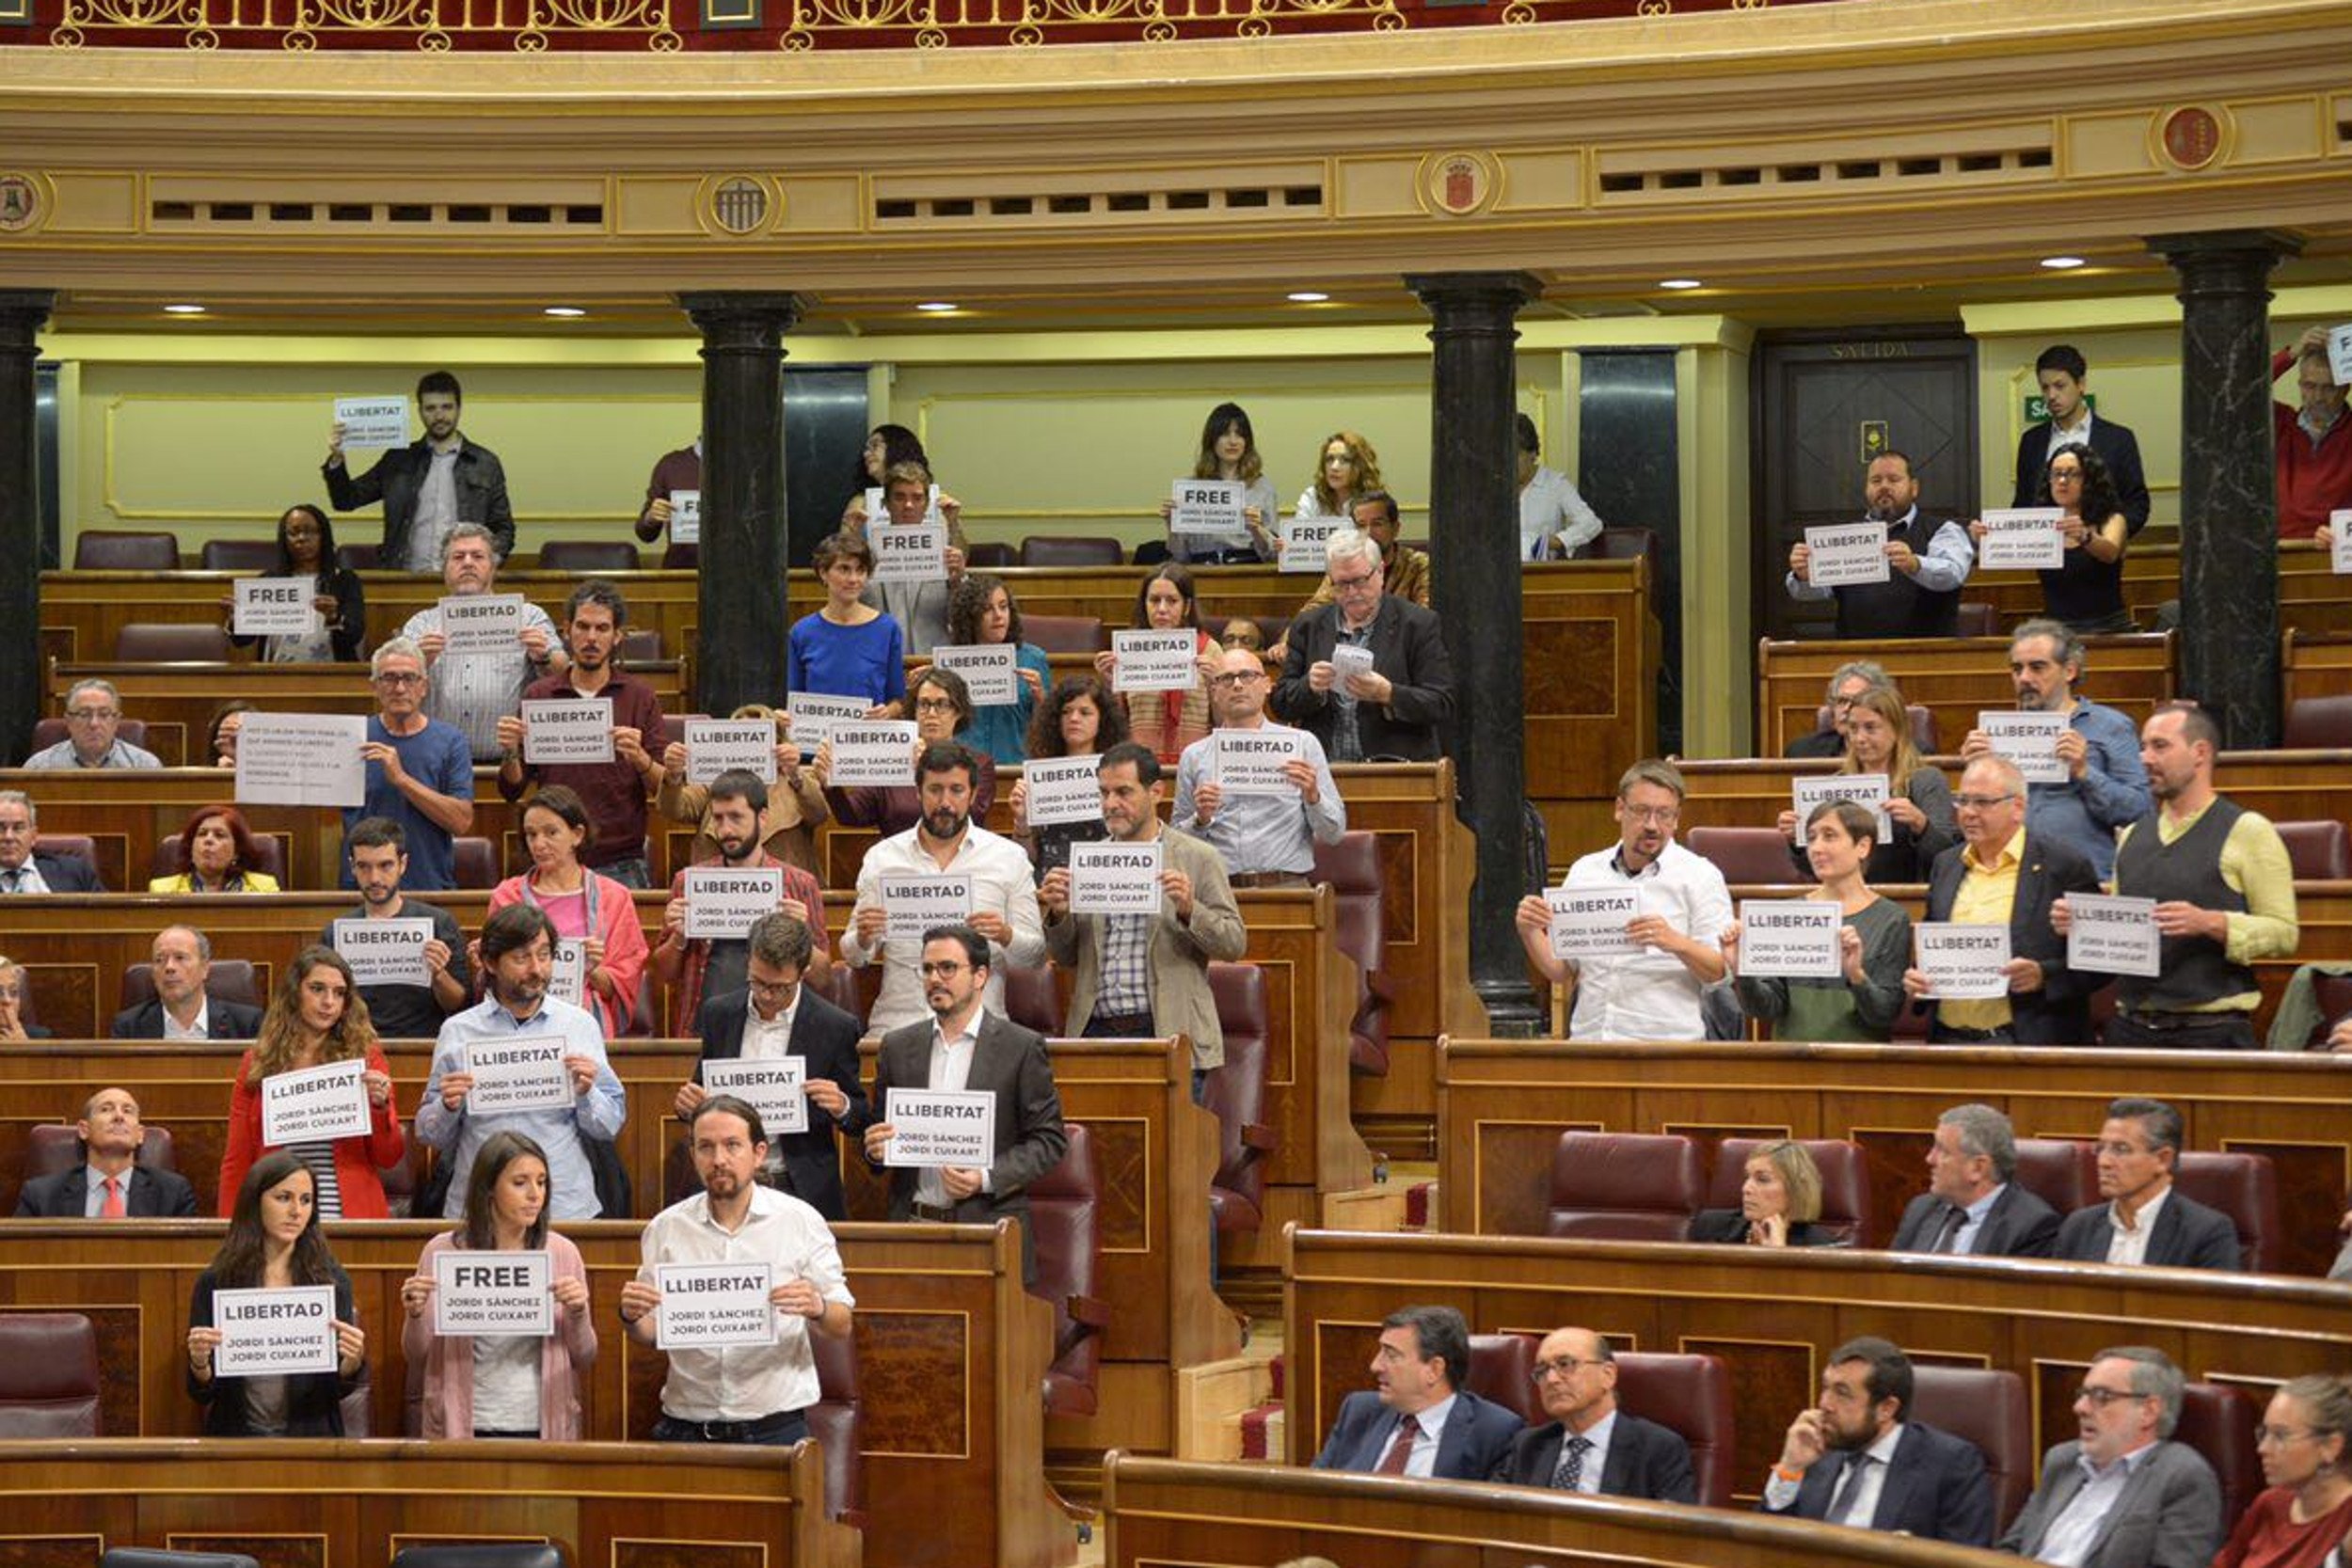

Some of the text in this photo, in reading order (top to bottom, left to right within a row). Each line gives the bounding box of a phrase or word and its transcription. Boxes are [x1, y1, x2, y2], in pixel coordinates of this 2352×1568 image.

[341, 405, 401, 418] LLIBERTAT
[1184, 490, 1231, 504] FREE
[1988, 519, 2055, 531] LLIBERTAT
[882, 534, 932, 549] FREE
[1812, 533, 1878, 548] LLIBERTAT
[249, 589, 299, 603] FREE
[447, 605, 516, 619] LIBERTAD
[1120, 640, 1189, 652] LIBERTAD
[941, 655, 1007, 668] LIBERTAD
[530, 710, 605, 723] LLIBERTAT
[795, 704, 863, 719] LIBERTAD
[692, 732, 768, 743] LLIBERTAT
[1986, 725, 2060, 737] LLIBERTAT
[835, 732, 911, 744] LIBERTAD
[1220, 741, 1294, 753] LIBERTAD
[1801, 788, 1879, 802] LLIBERTAT
[1077, 855, 1153, 867] LIBERTAD
[694, 880, 773, 894] LIBERTAD
[886, 884, 965, 899] LIBERTAD
[1080, 894, 1149, 903] JORDI CUIXART
[1552, 897, 1634, 914] LLIBERTAT
[1748, 914, 1831, 927] LLIBERTAT
[2075, 909, 2150, 924] LLIBERTAT
[344, 931, 423, 944] LIBERTAD
[1925, 937, 2000, 950] LLIBERTAT
[473, 1048, 561, 1067] LLIBERTAT
[711, 1071, 795, 1087] LLIBERTAT
[271, 1074, 356, 1100] LLIBERTAT
[477, 1081, 510, 1091] JORDI
[480, 1089, 561, 1103] JORDI CUIXART
[273, 1110, 307, 1122] JORDI
[896, 1103, 984, 1119] LLIBERTAT
[277, 1116, 358, 1132] JORDI CUIXART
[899, 1132, 930, 1142] JORDI
[898, 1145, 980, 1156] JORDI CUIXART
[455, 1266, 530, 1287] FREE
[666, 1275, 765, 1294] LLIBERTAT
[446, 1298, 482, 1307] JORDI
[226, 1302, 323, 1321] LIBERTAD
[449, 1311, 539, 1321] JORDI CUIXART
[668, 1311, 706, 1322] JORDI
[671, 1323, 762, 1336] JORDI CUIXART
[228, 1338, 264, 1349] JORDI
[230, 1349, 320, 1362] JORDI CUIXART
